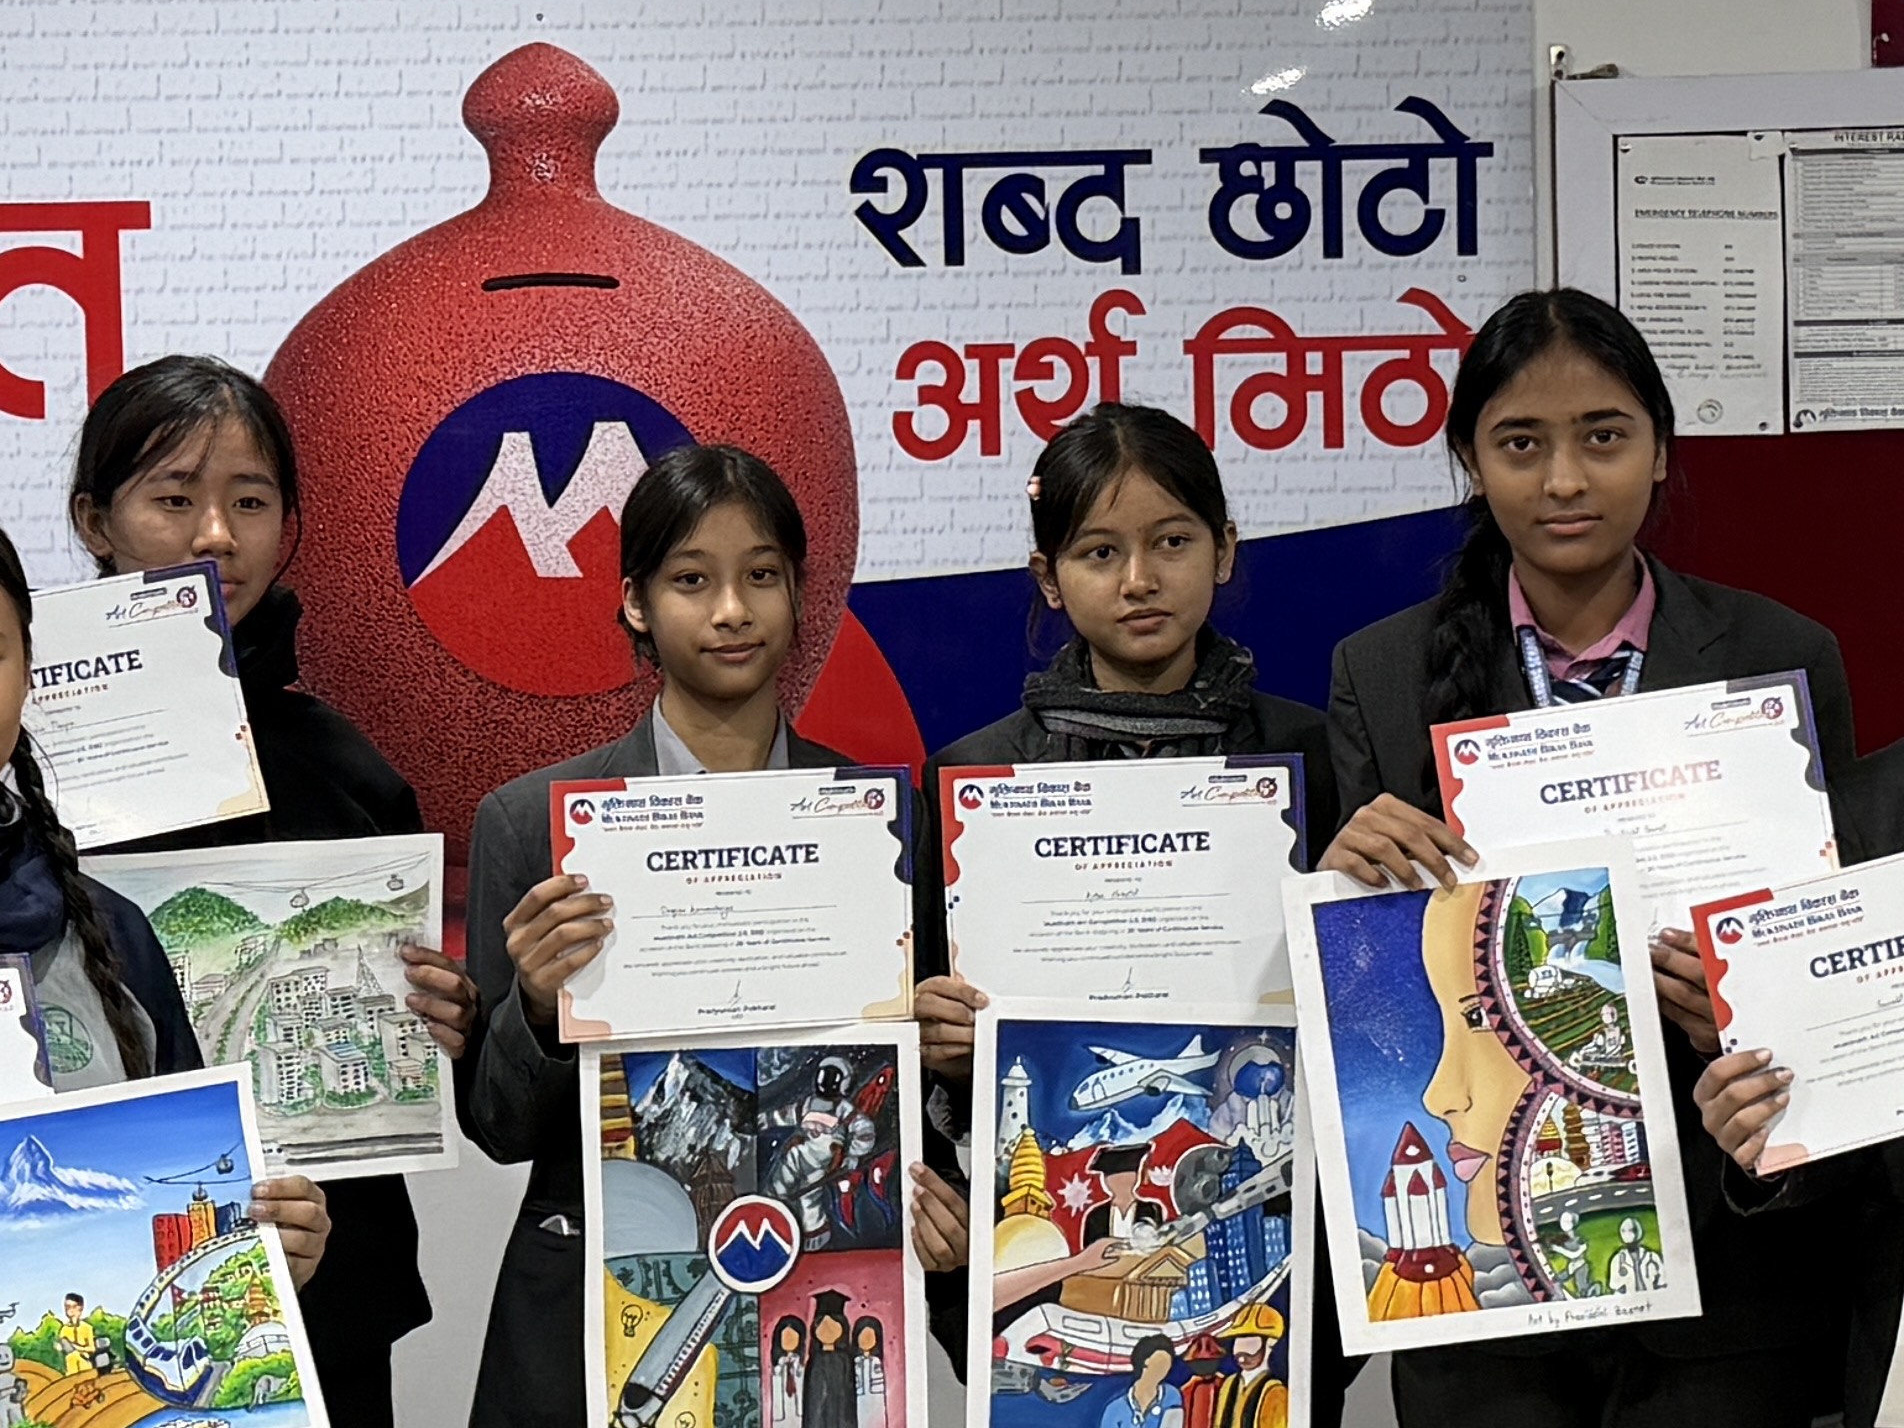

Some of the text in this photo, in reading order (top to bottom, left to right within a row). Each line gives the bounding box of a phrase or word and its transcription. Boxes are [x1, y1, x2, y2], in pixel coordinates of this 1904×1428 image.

[850, 95, 1493, 275] शब्द छोटो
[891, 289, 1148, 462] अर्थ
[1540, 760, 1722, 805] CERTIFICATE
[647, 843, 819, 872] CERTIFICATE
[1035, 831, 1210, 859] CERTIFICATE
[704, 873, 782, 883] APPRECIATION
[1092, 860, 1173, 870] APPRECIATION
